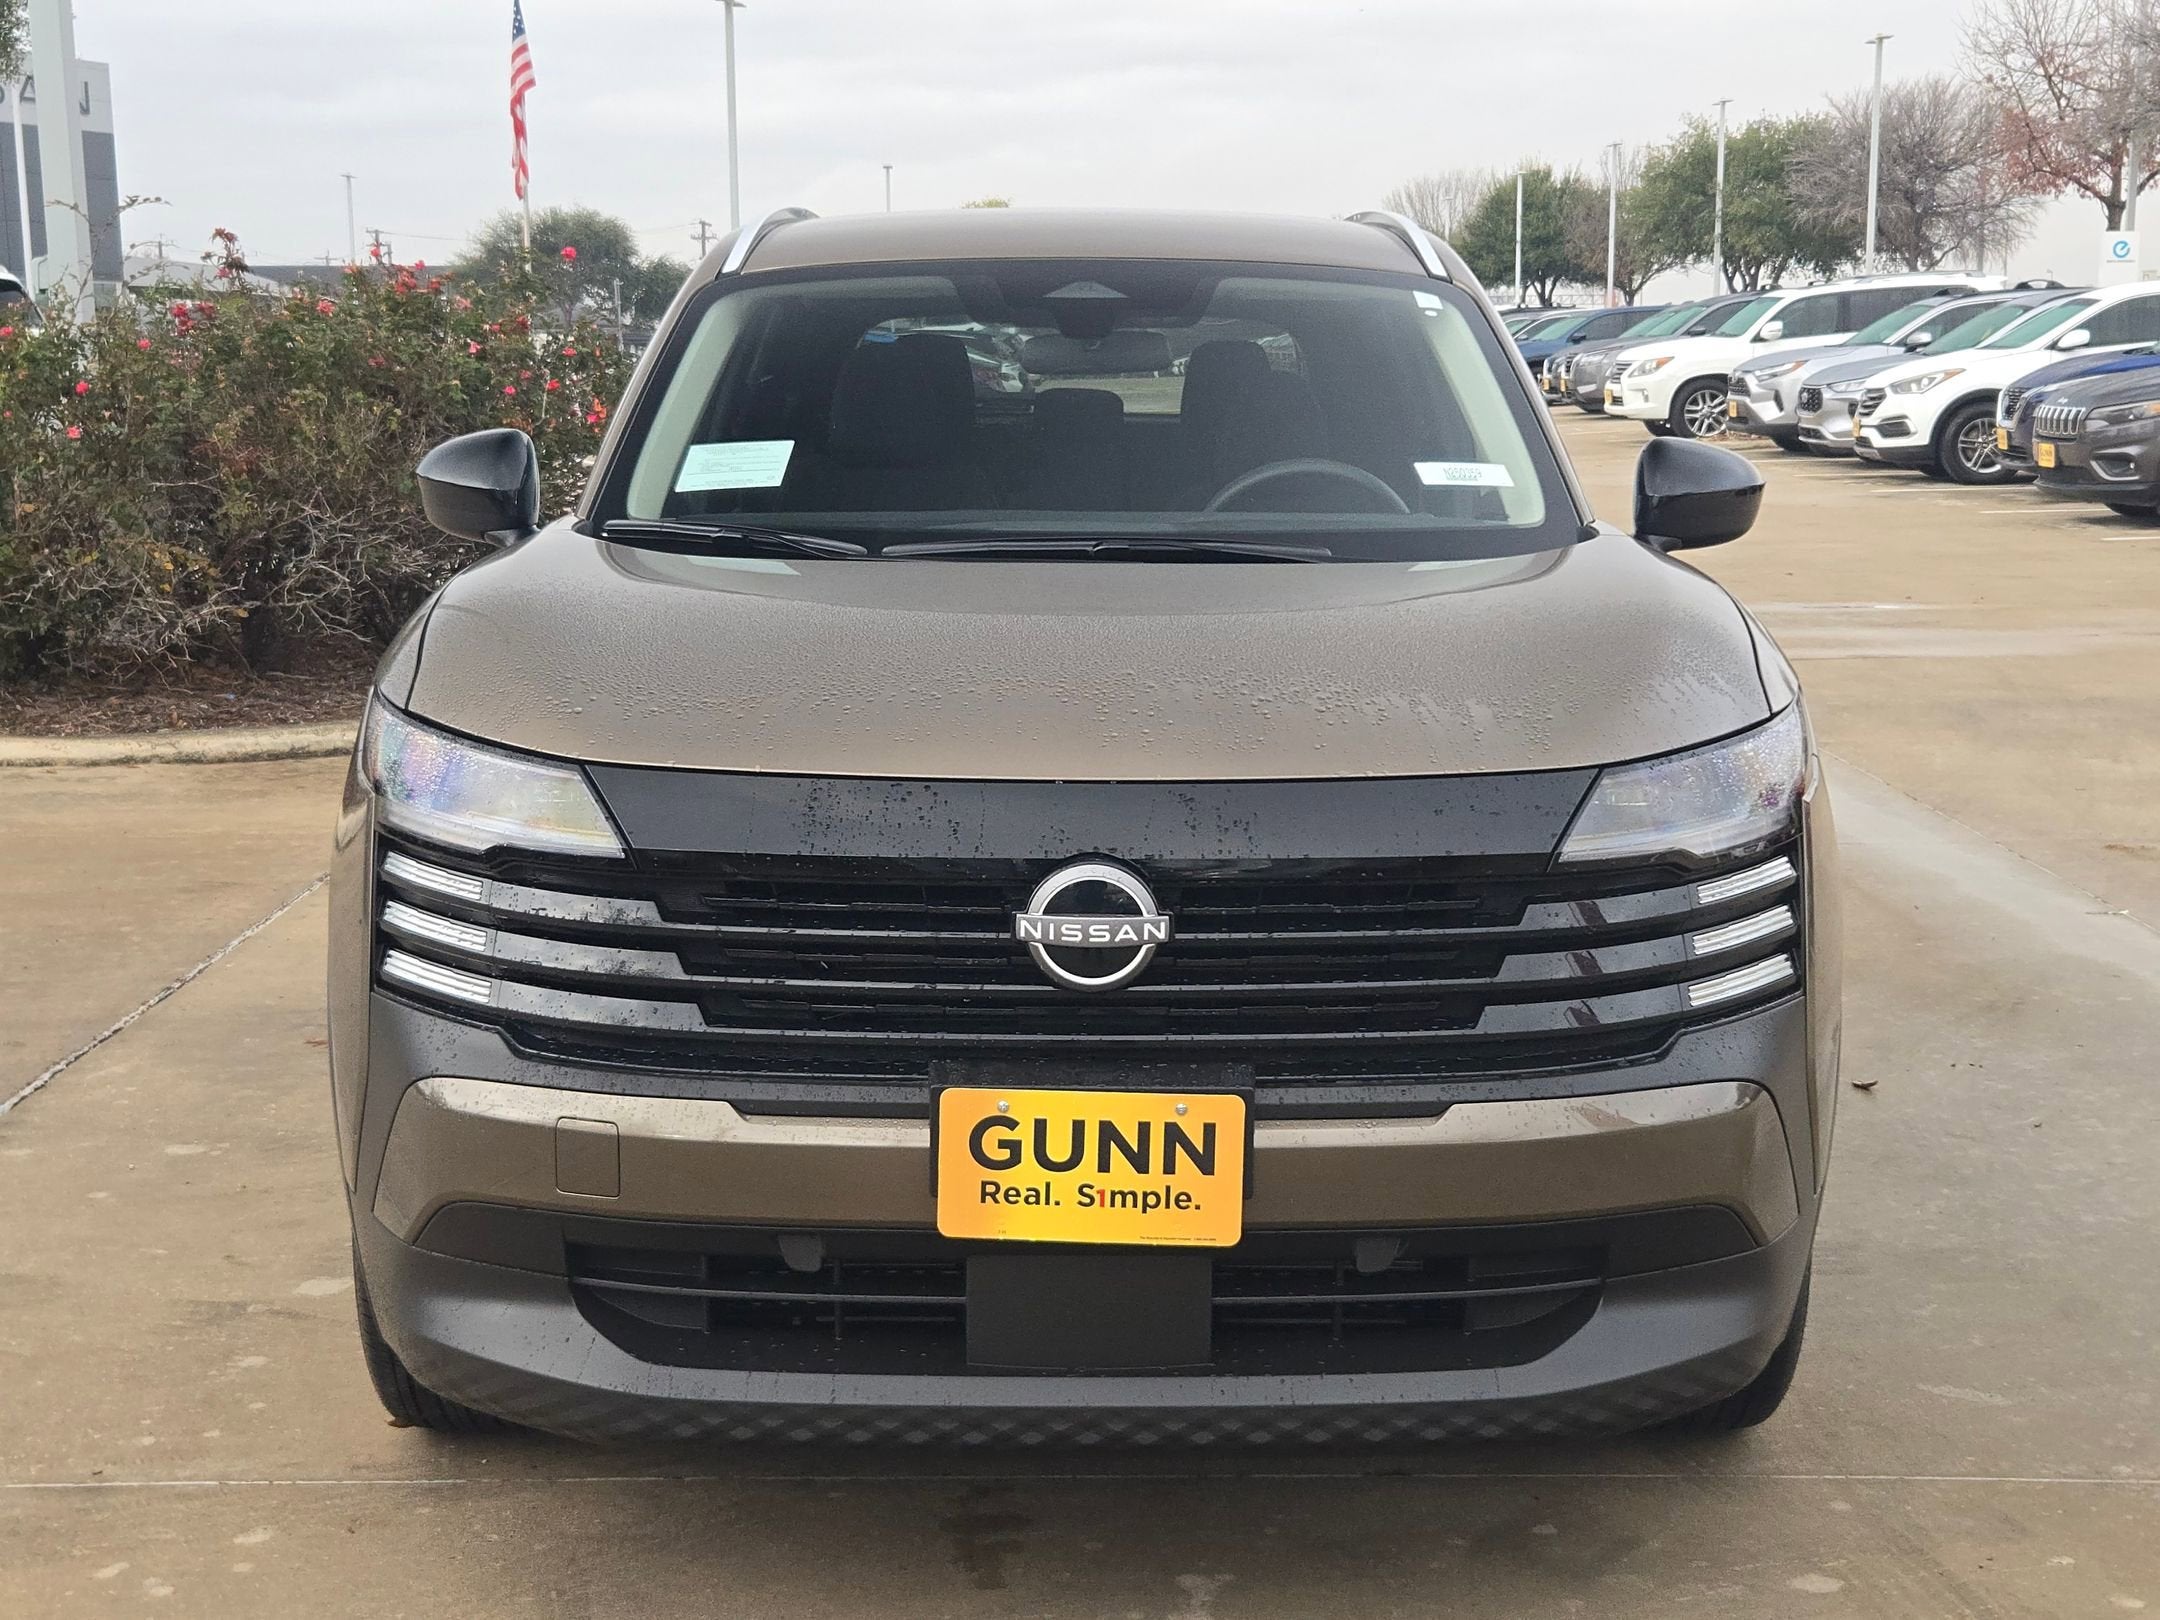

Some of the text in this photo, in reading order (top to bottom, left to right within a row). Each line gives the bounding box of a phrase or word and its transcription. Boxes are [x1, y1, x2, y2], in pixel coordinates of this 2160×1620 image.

[1019, 919, 1166, 943] NISSAN
[968, 1114, 1217, 1176] GUNN
[980, 1179, 1061, 1207] Real.
